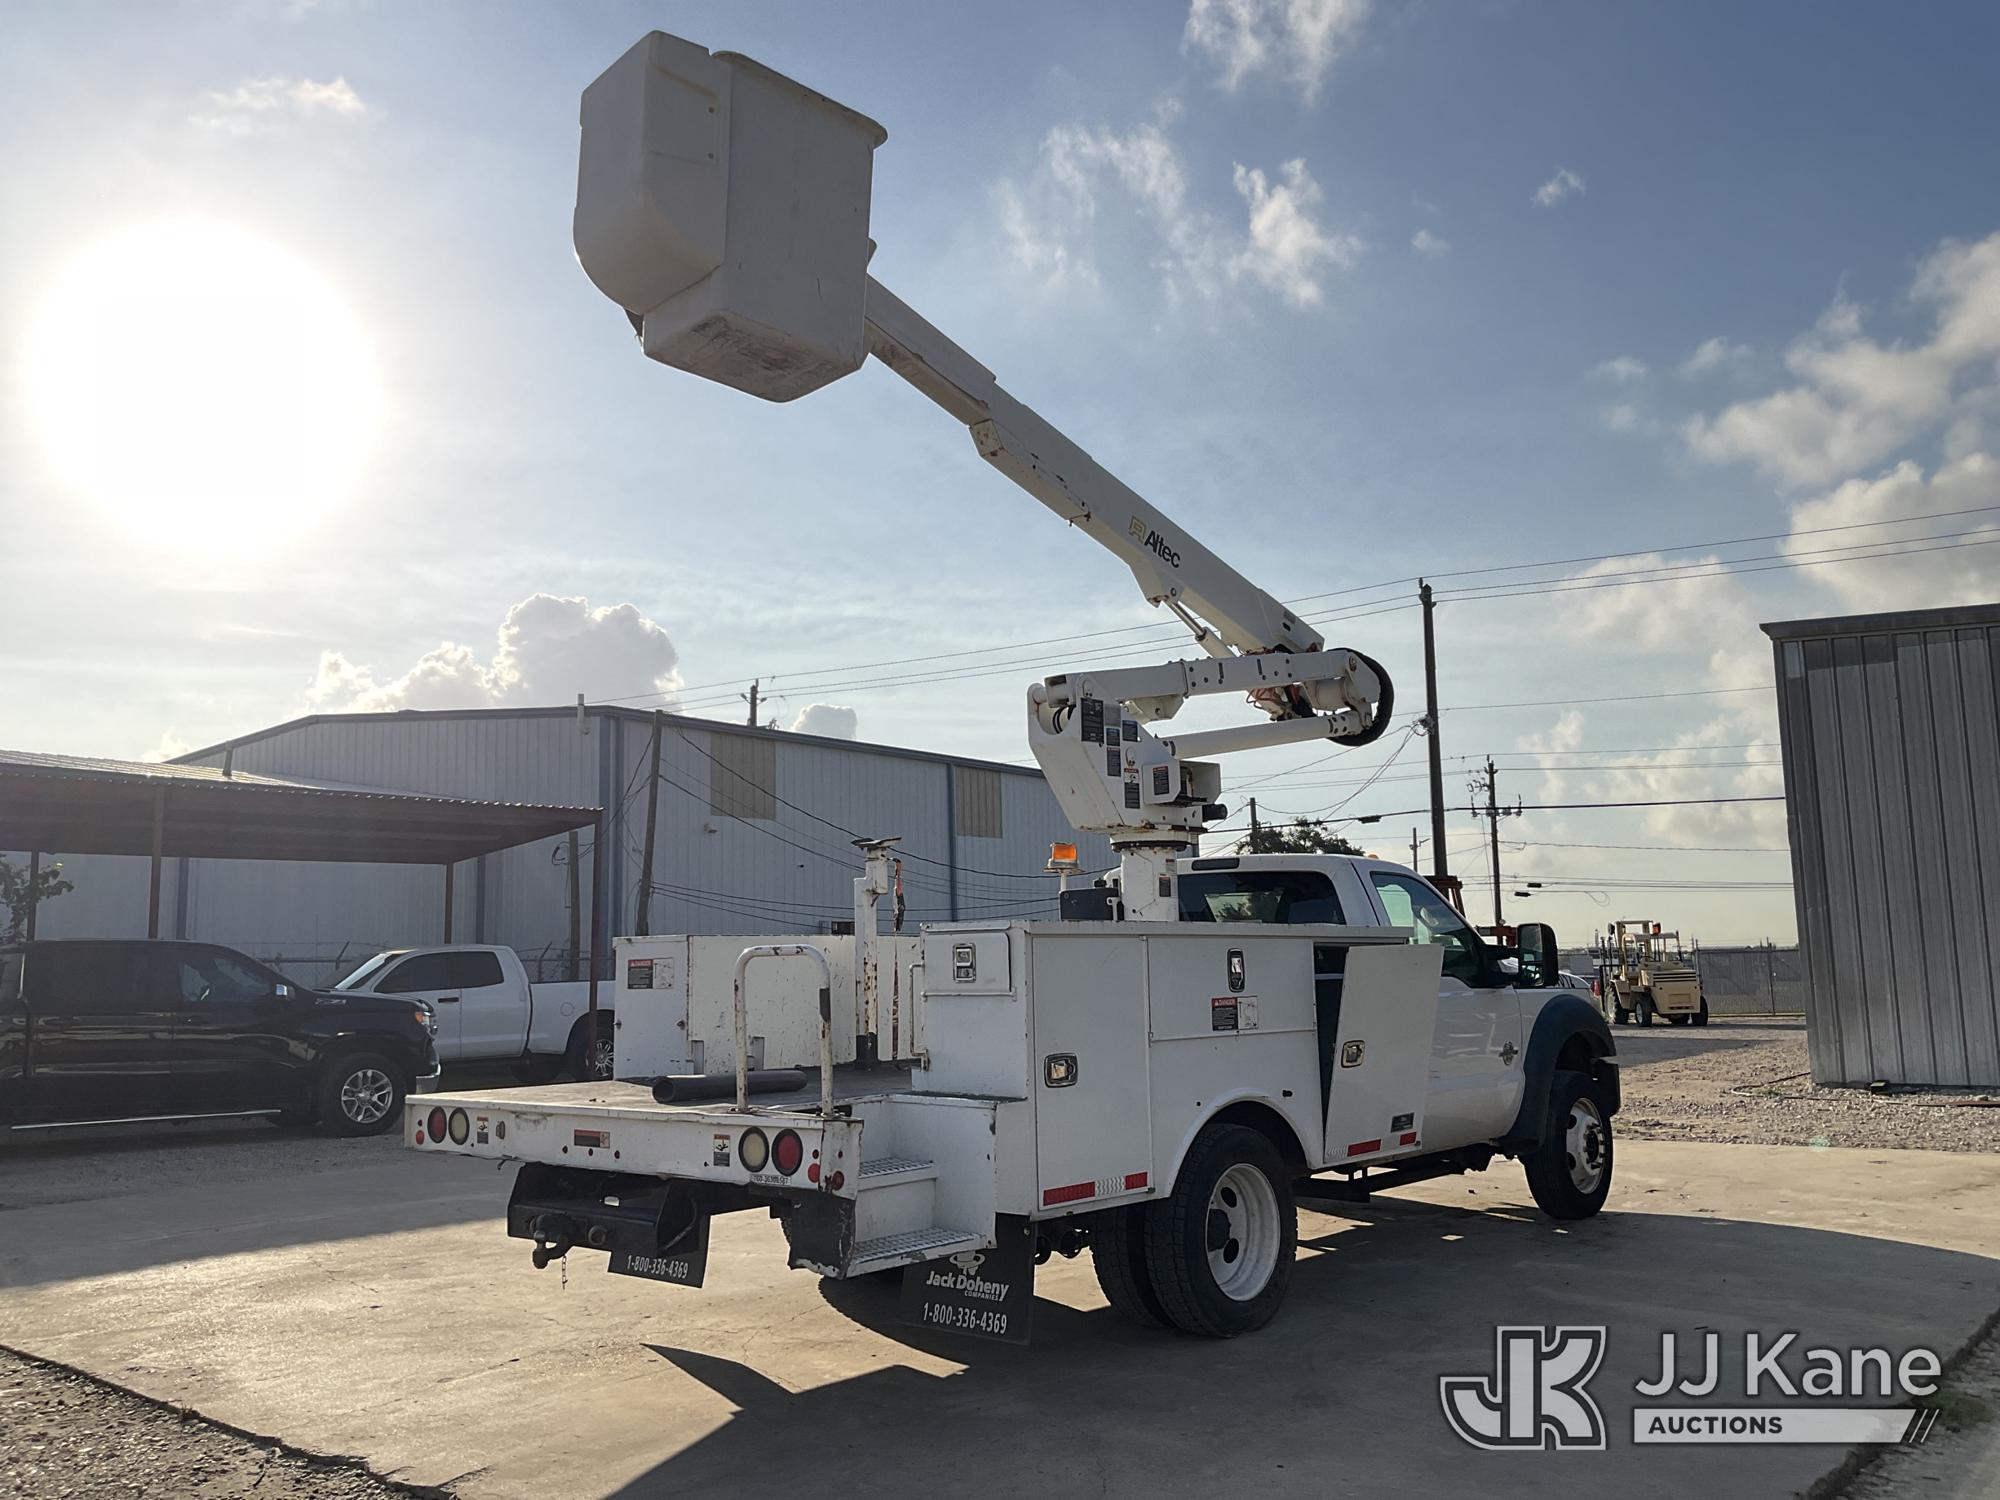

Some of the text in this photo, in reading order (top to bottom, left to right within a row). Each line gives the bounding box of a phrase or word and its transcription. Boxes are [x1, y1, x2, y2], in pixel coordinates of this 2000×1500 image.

[1144, 530, 1181, 568] Altec
[627, 1254, 689, 1279] 1-800-336-4369
[926, 1270, 1010, 1302] Jack Doheny
[964, 1290, 999, 1301] COMPANIES
[923, 1301, 1008, 1335] 1-800-336-4369
